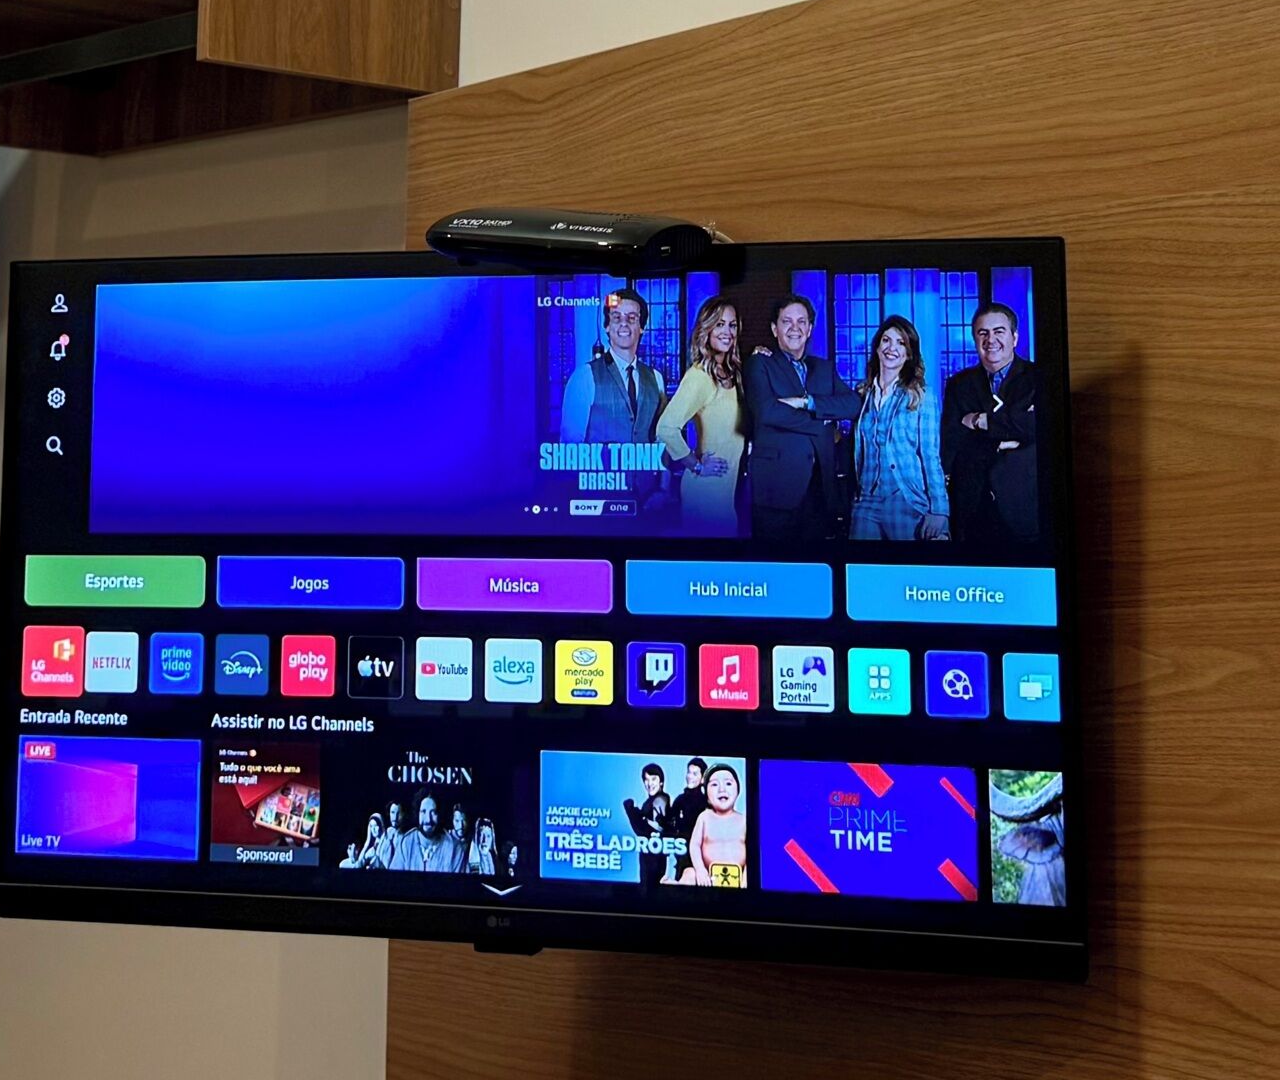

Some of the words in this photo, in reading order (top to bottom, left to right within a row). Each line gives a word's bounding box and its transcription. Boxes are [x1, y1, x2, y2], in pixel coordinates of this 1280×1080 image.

[569, 225, 613, 233] VIVENSIS
[537, 296, 552, 307] LG
[554, 296, 600, 307] Channels
[539, 442, 604, 471] SHARK
[607, 442, 667, 471] TANK
[578, 472, 628, 491] BRASIL
[84, 573, 145, 591] Esportes
[289, 575, 330, 592] Jogos
[489, 577, 540, 594] Música
[689, 581, 720, 596] Hub
[723, 582, 768, 598] Inicial
[905, 585, 951, 602] Home
[955, 586, 1005, 604] Office
[161, 646, 192, 660] prime
[288, 651, 326, 668] globo
[31, 659, 46, 671] LG
[92, 656, 131, 670] NETFLIX
[162, 658, 192, 672] video
[220, 660, 263, 679] Disney+
[373, 657, 394, 677] tv
[437, 663, 468, 675] YouTube
[493, 655, 535, 674] alexa
[30, 671, 74, 684] Channels
[299, 667, 328, 681] play
[564, 668, 605, 678] mercado
[780, 667, 795, 679] LG
[575, 677, 594, 687] play
[780, 680, 818, 693] Gaming
[718, 690, 749, 701] Music
[780, 692, 812, 703] Portal
[868, 692, 892, 701] APPS
[20, 708, 71, 724] Entrada
[74, 710, 128, 726] Recente
[210, 713, 265, 730] Assistir
[267, 718, 286, 730] no
[289, 715, 308, 731] LG
[311, 715, 375, 733] Channels
[29, 745, 52, 757] LIVE
[406, 751, 429, 764] The
[220, 762, 239, 772] Tudo
[240, 764, 246, 772] o
[247, 764, 262, 774] que
[263, 764, 282, 773] você
[283, 766, 301, 774] ama
[387, 765, 472, 785] CHOSEN
[218, 774, 237, 784] está
[546, 806, 580, 816] JACKIE
[582, 807, 611, 818] CHAN
[546, 815, 575, 825] LOUIS
[576, 817, 598, 827] KOO
[829, 806, 908, 833] PRIME
[21, 834, 43, 847] Live
[45, 835, 61, 847] TV
[545, 829, 593, 850] TRÊS
[596, 831, 687, 856] LADRÕES
[829, 829, 893, 853] TIME
[236, 847, 293, 863] Sponsored
[546, 850, 553, 861] E
[553, 851, 570, 862] UM
[572, 850, 622, 870] BEBÊ
